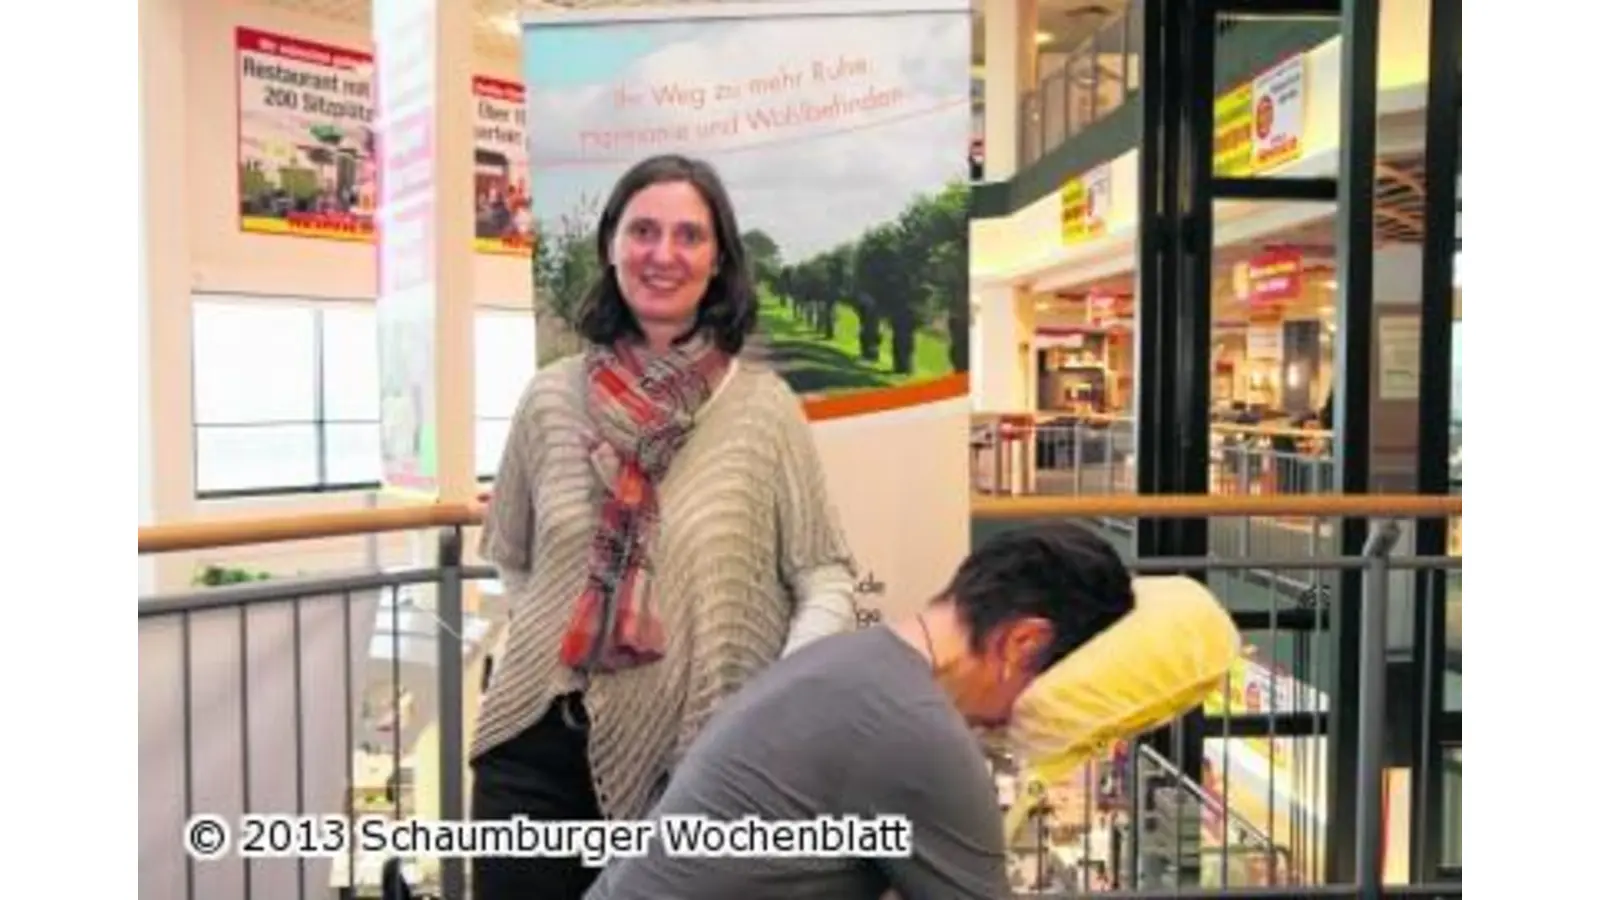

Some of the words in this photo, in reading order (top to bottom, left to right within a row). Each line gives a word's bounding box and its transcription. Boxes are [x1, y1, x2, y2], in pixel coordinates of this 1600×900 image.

[243, 55, 338, 93] Restaurant
[343, 80, 370, 99] mit
[650, 81, 706, 110] Weg
[748, 64, 804, 96] mehr
[263, 86, 298, 110] 200
[301, 92, 375, 122] Sitzplätz
[697, 111, 739, 138] und
